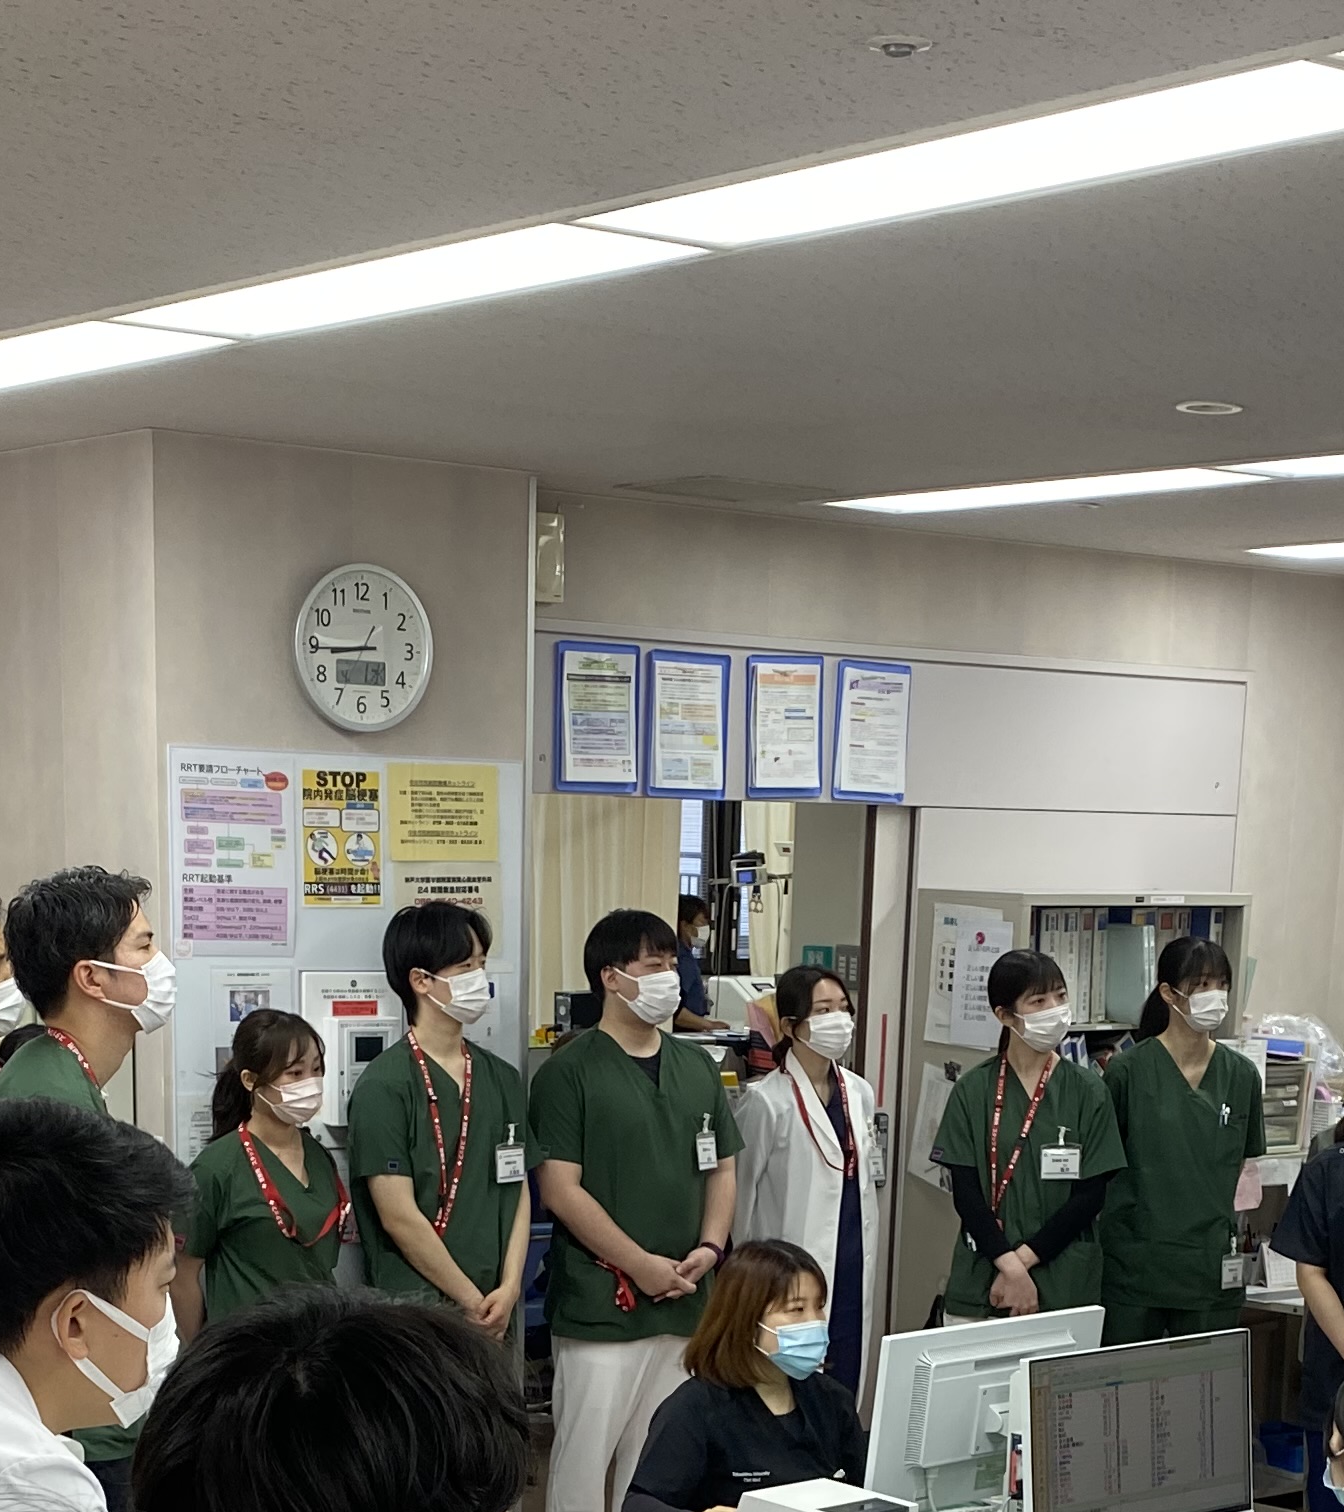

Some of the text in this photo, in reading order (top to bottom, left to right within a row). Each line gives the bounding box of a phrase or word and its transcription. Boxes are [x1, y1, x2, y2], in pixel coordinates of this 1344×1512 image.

[332, 587, 345, 607] 11
[354, 582, 370, 601] 12
[382, 592, 388, 610] 1
[315, 608, 331, 627] 10
[396, 613, 406, 631] 2
[309, 635, 319, 654] 9
[404, 643, 414, 661] 3
[316, 664, 327, 683] 8
[395, 671, 406, 689] 4
[334, 687, 344, 706] 7
[356, 696, 367, 714] 6
[380, 690, 390, 708] 5
[316, 771, 367, 789] STOP
[305, 884, 325, 894] RRS
